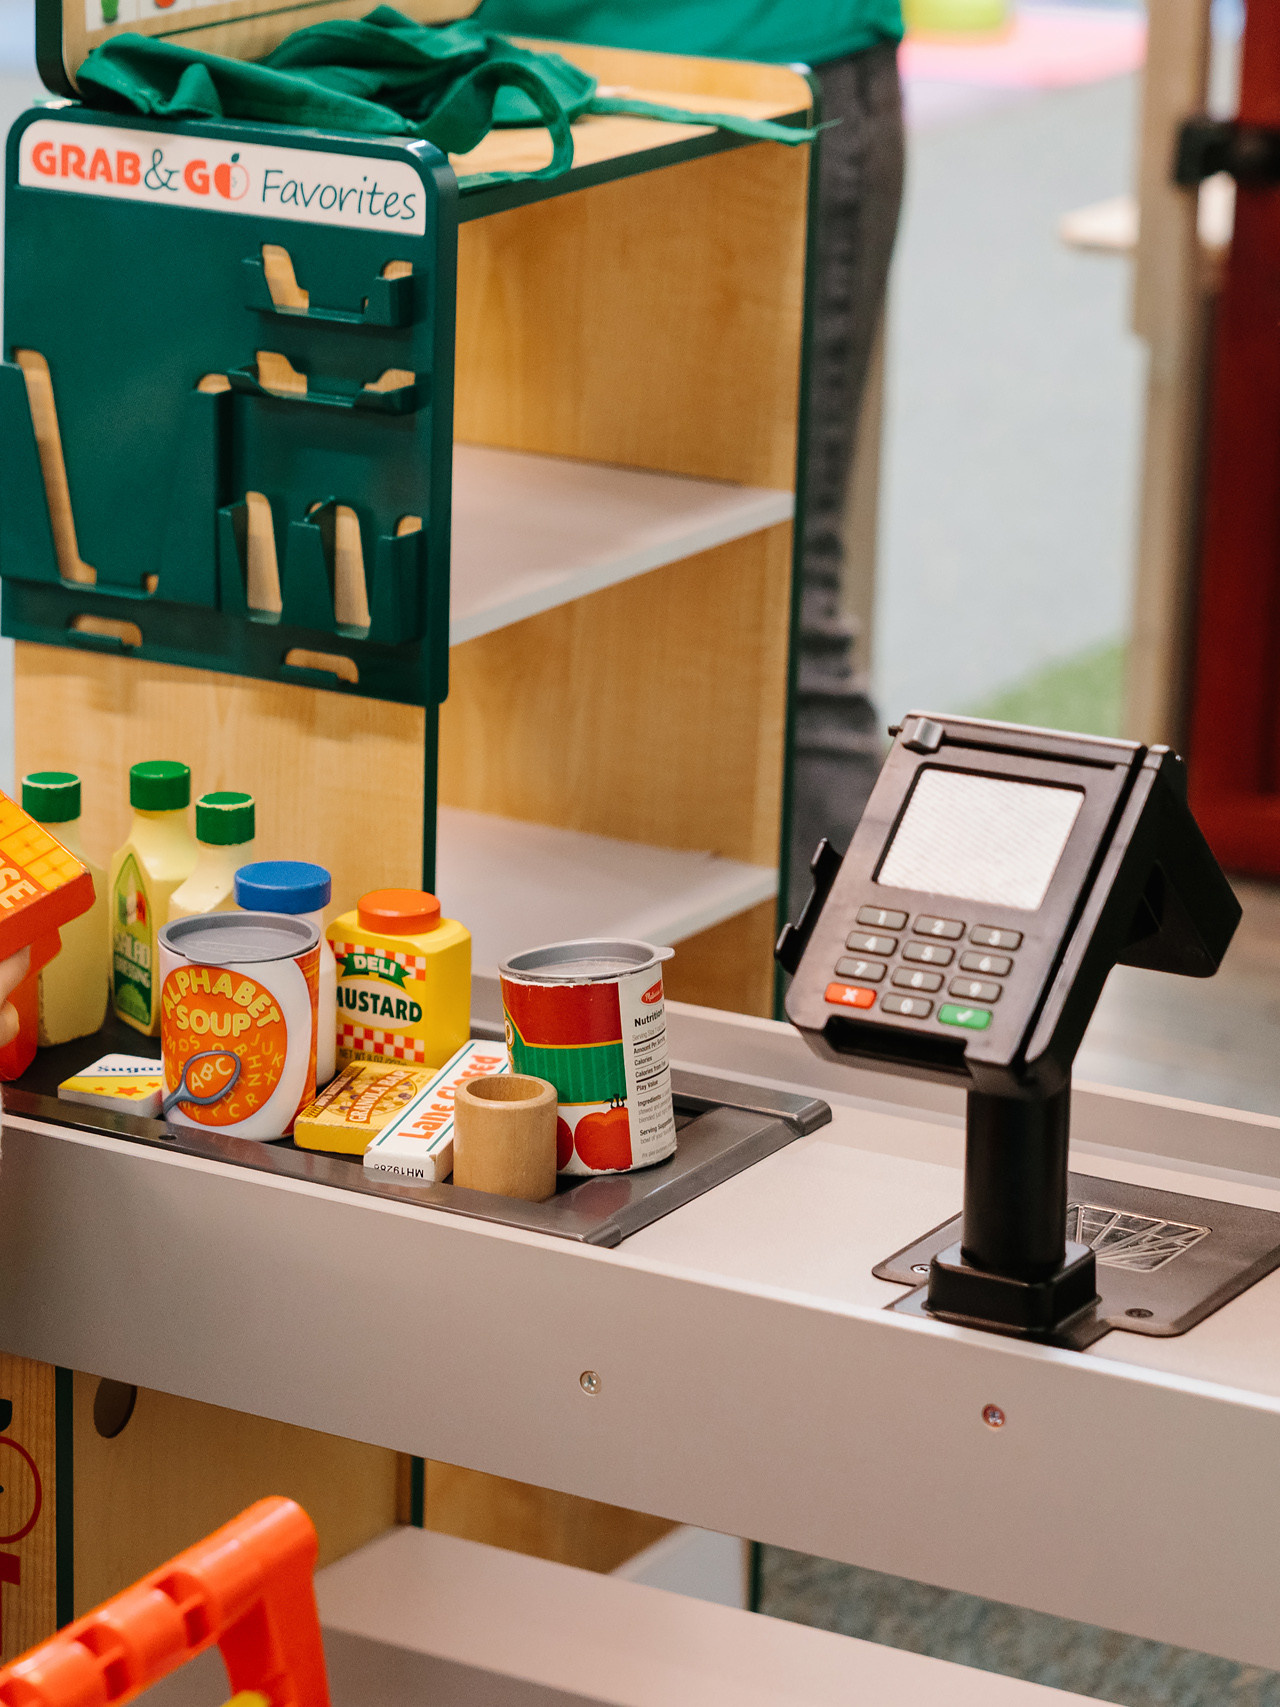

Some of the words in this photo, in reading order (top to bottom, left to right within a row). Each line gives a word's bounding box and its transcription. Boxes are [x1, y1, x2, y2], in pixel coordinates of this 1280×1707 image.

[261, 169, 416, 220] Favorites
[878, 911, 886, 925] 1
[932, 920, 945, 935] 2
[988, 930, 1001, 945] 3
[353, 955, 396, 976] DELI
[864, 937, 877, 952] 4
[921, 946, 934, 961] 5
[979, 957, 991, 971] 6
[854, 962, 868, 975] 7
[911, 972, 924, 987] 8
[970, 982, 982, 997] 9
[163, 969, 280, 1027] ALPHABET
[900, 999, 913, 1014] 0
[176, 1005, 251, 1037] SOUP
[191, 1058, 232, 1090] ABC
[634, 1056, 652, 1066] Calories
[349, 1084, 390, 1121] GRANOLA
[397, 1104, 455, 1140] Lane
